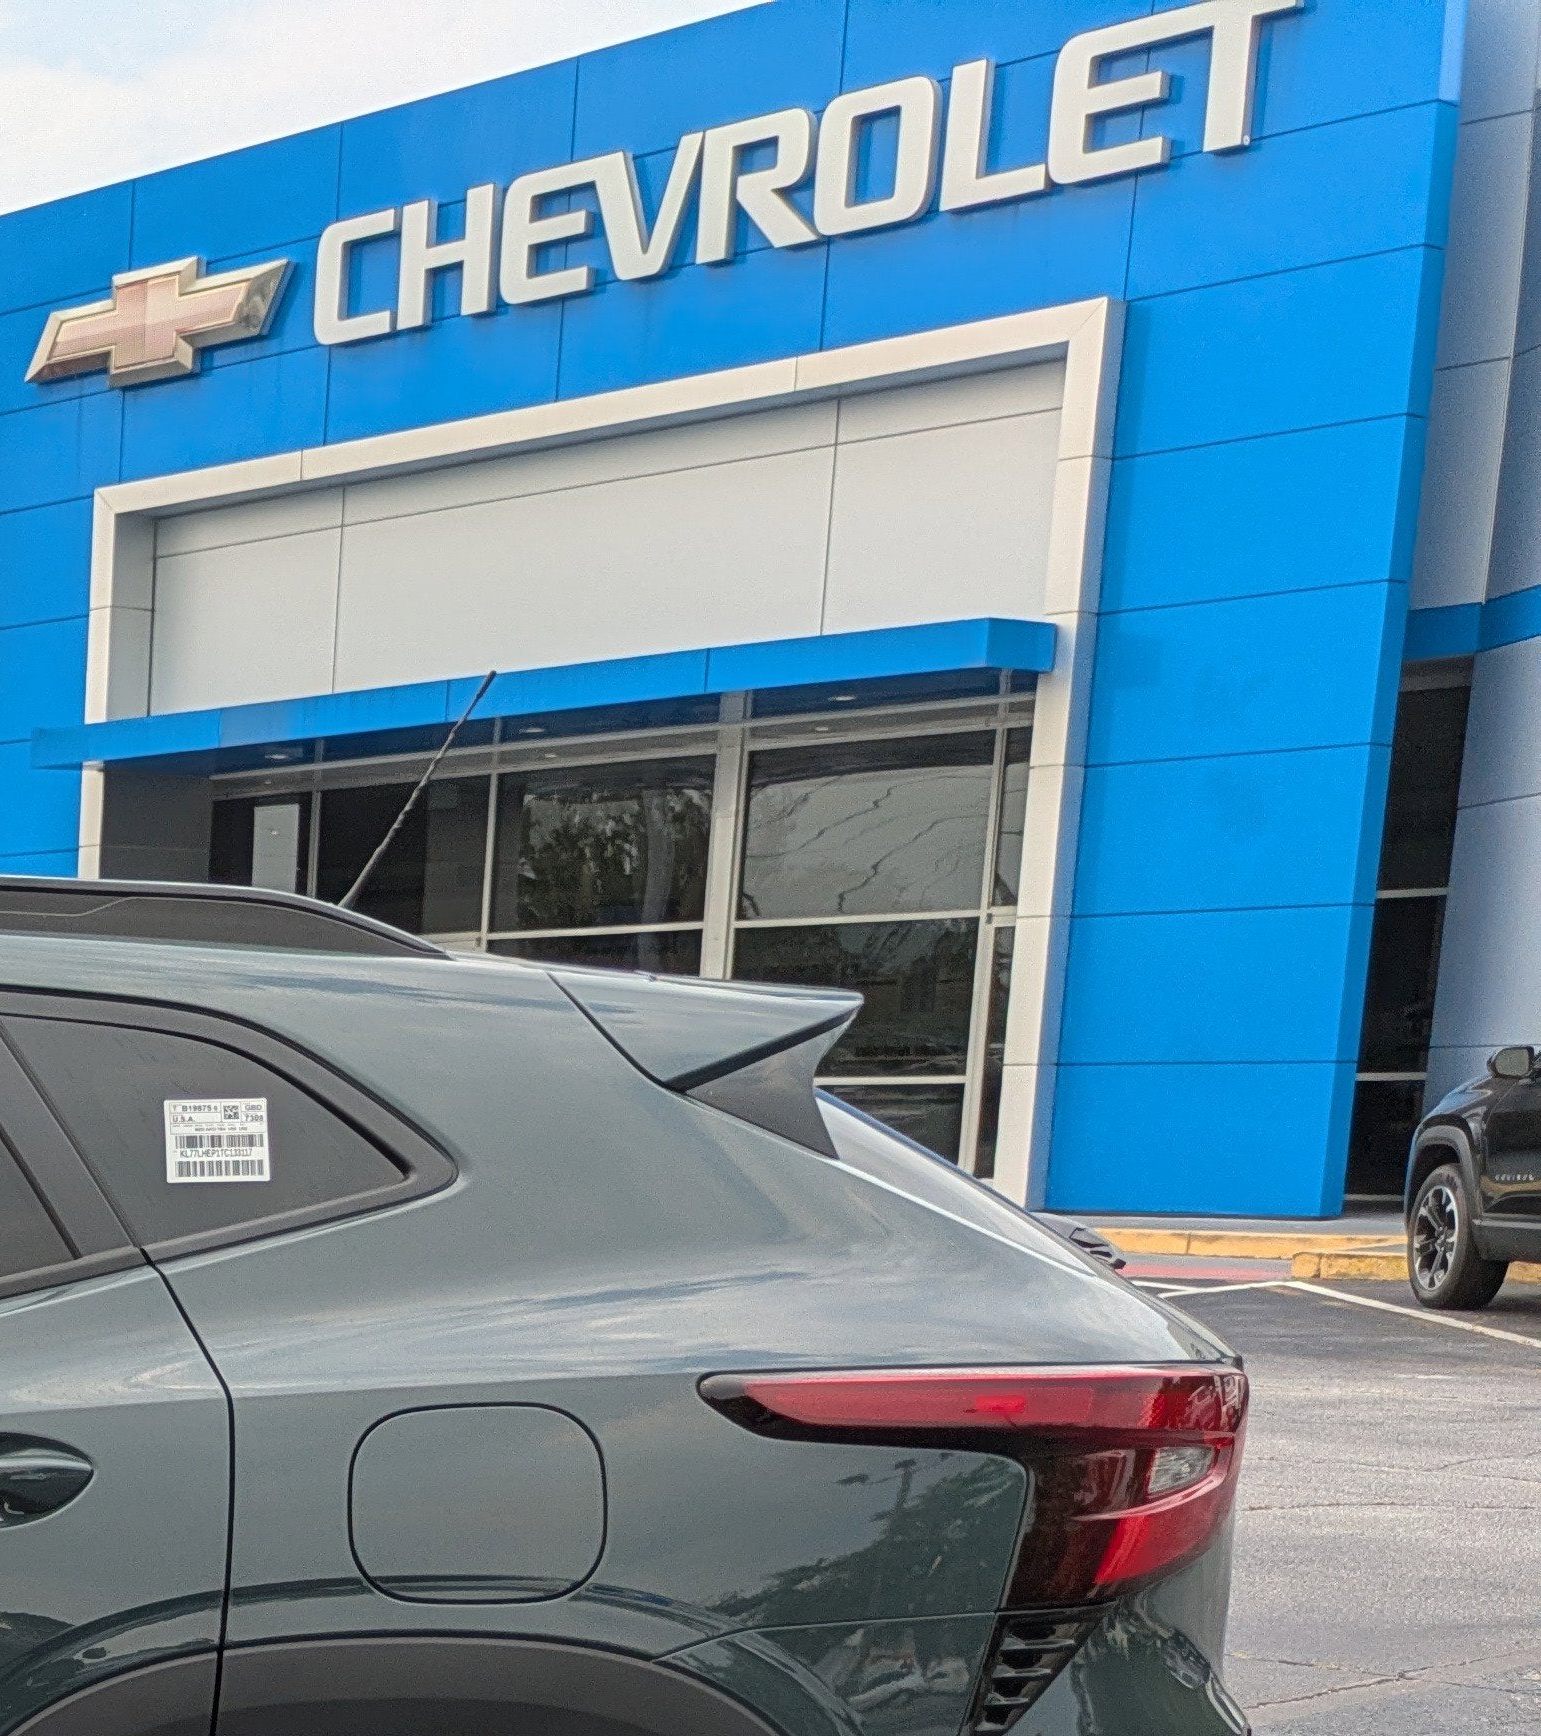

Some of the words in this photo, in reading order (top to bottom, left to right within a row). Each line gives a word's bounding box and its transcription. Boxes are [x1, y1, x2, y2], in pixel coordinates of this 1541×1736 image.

[312, 0, 1305, 346] CHEVROLET
[172, 1115, 196, 1123] U.S.A.
[179, 1148, 253, 1158] KL77LHEP1TC133117
